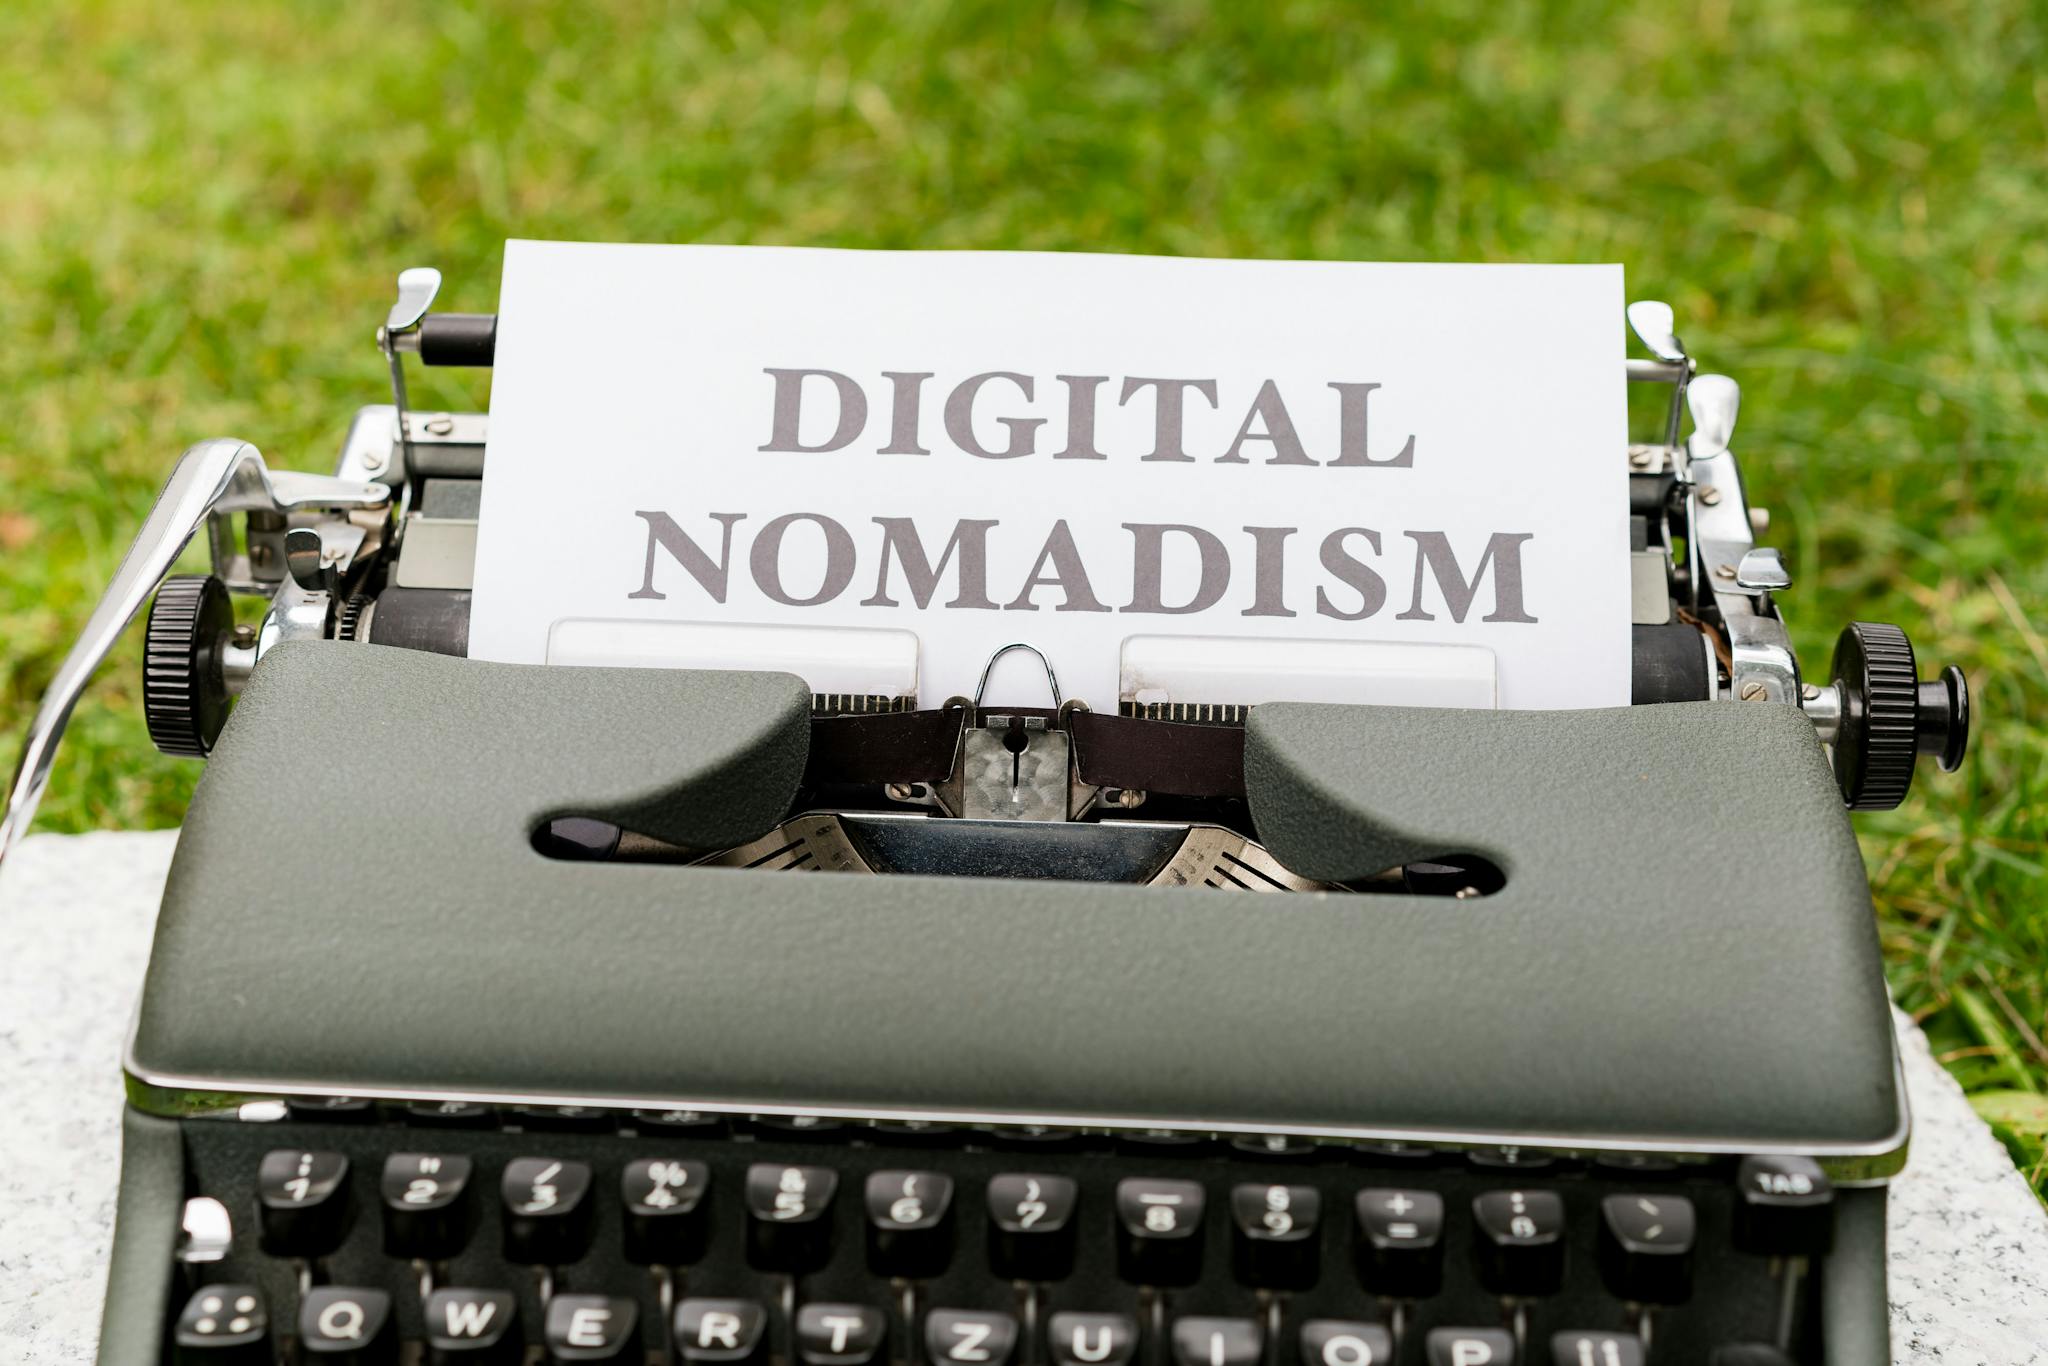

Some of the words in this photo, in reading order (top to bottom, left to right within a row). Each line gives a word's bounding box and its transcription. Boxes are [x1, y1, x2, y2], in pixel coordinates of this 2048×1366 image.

[757, 366, 1416, 469] DIGITAL
[627, 510, 1539, 624] NOMADISM
[404, 1178, 438, 1203] 2
[524, 1184, 557, 1212] 3
[890, 1197, 923, 1223] 6
[1145, 1205, 1177, 1232] 8
[1263, 1211, 1293, 1236] 9
[318, 1300, 365, 1340] Q
[445, 1301, 497, 1337] W
[567, 1308, 612, 1347] E
[698, 1311, 742, 1349] R
[820, 1315, 864, 1353] T
[949, 1322, 992, 1361] Z
[1072, 1325, 1113, 1362] U
[1210, 1331, 1225, 1366] I
[1322, 1334, 1373, 1366] O
[1451, 1338, 1493, 1366] P
